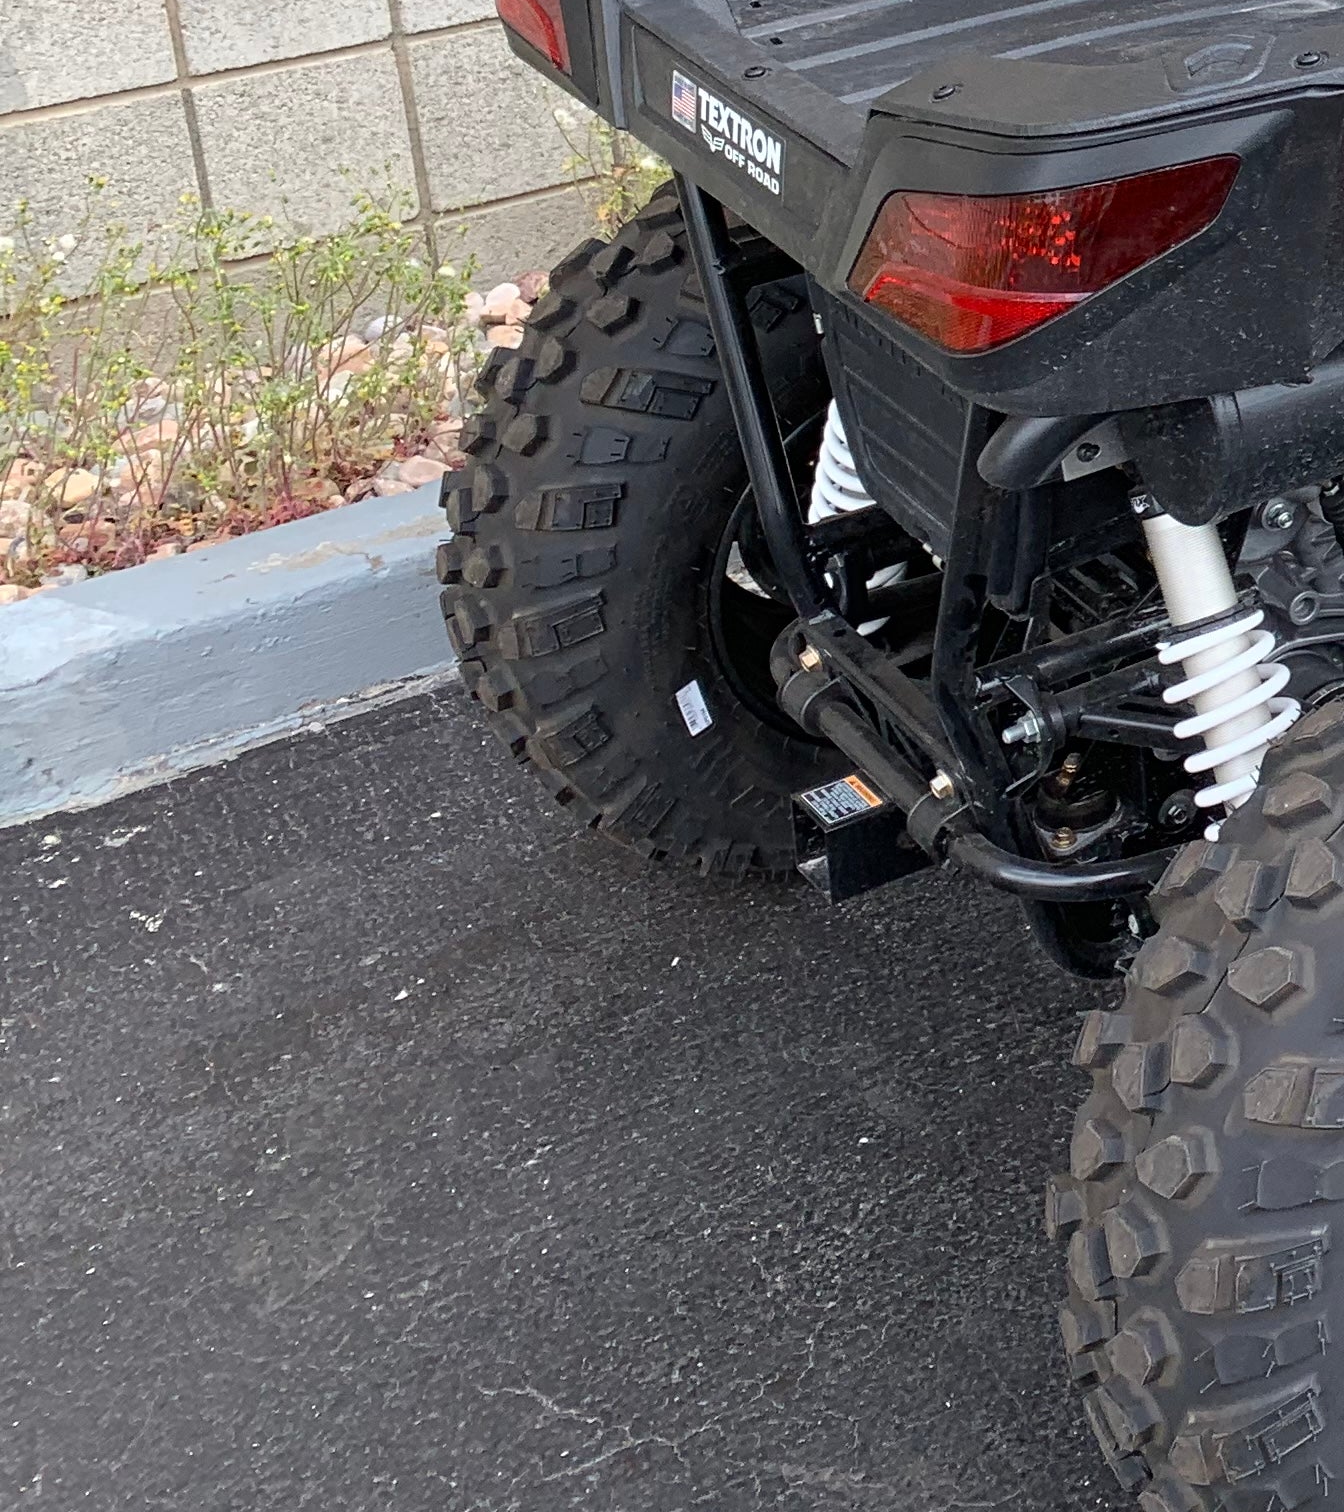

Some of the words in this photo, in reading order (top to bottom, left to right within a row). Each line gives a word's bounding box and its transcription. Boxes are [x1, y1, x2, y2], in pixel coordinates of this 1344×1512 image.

[698, 87, 782, 175] TEXTRON
[724, 146, 746, 169] OFF
[747, 160, 780, 195] ROAD
